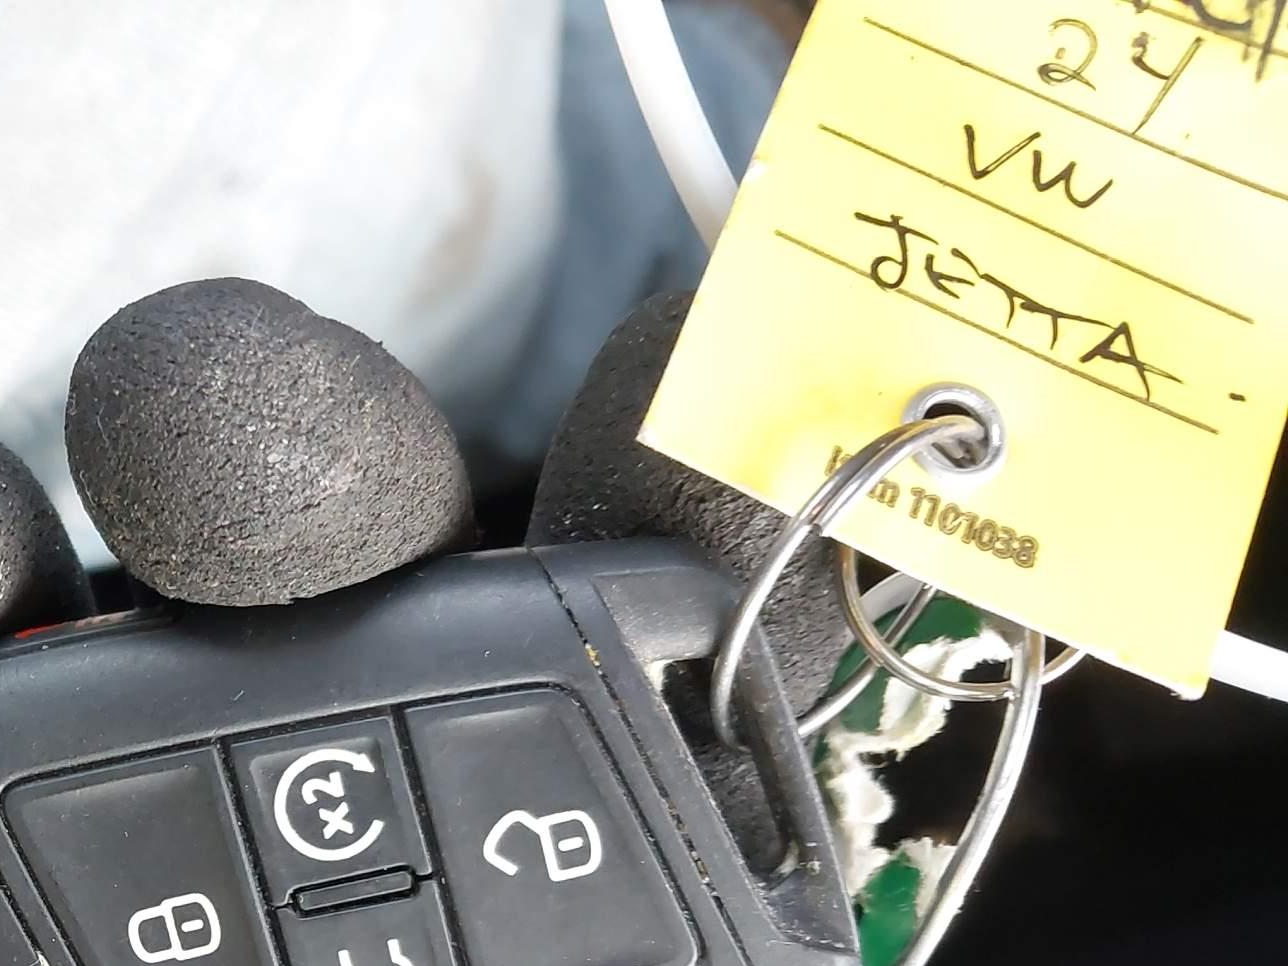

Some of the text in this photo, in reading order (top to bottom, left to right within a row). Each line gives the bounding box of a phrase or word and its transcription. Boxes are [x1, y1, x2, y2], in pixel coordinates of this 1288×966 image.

[1036, 17, 1205, 136] 24
[963, 123, 1114, 209] VW
[823, 444, 1040, 569] Im 1101038
